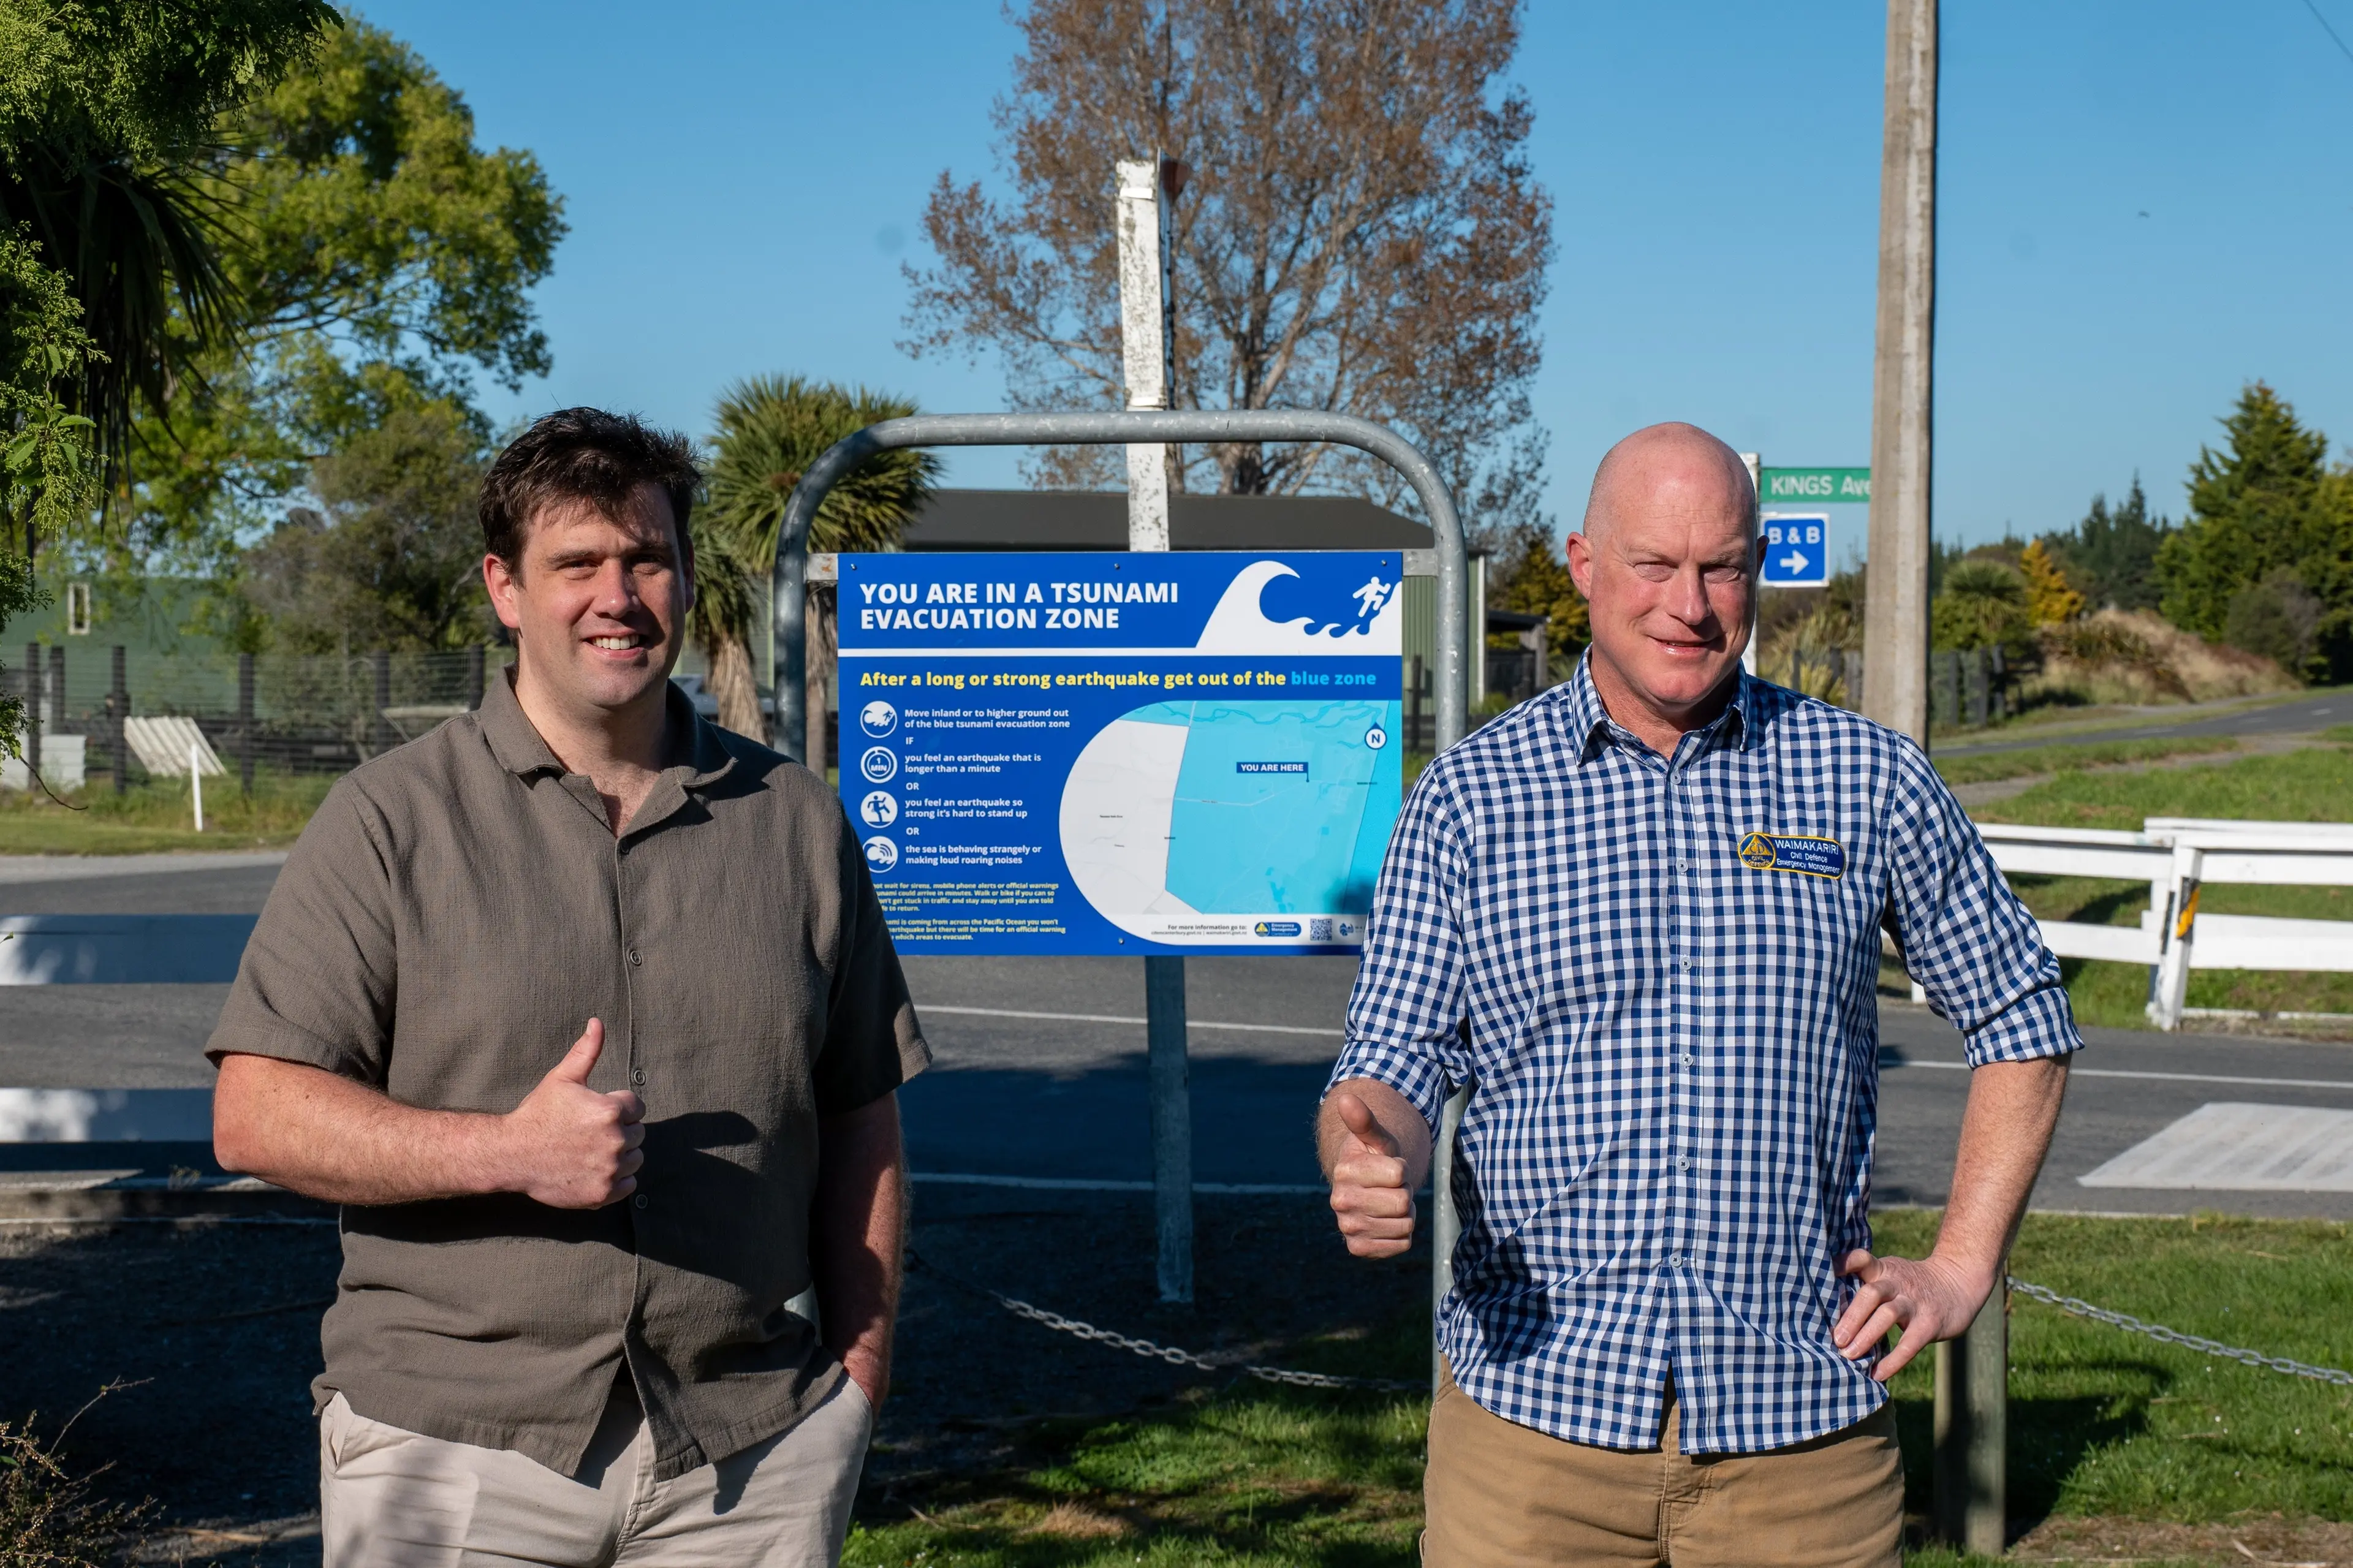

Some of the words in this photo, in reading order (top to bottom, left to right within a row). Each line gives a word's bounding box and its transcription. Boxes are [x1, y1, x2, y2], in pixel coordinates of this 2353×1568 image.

[1771, 475, 1833, 496] KINGS
[1840, 475, 1872, 496] Ave
[1768, 526, 1783, 545] B
[1787, 526, 1802, 545] &
[1806, 526, 1820, 545] B
[860, 584, 917, 604] YOU
[926, 583, 977, 603] ARE
[987, 583, 1015, 603] IN
[1025, 583, 1043, 603] A
[1051, 583, 1177, 603] TSUNAMI
[862, 608, 1036, 629] EVACUATION
[1045, 608, 1118, 628] ZONE
[860, 672, 906, 686] After
[911, 675, 921, 686] a
[927, 672, 964, 689] long
[969, 675, 988, 686] or
[993, 673, 1051, 689] strong
[1056, 672, 1159, 689] earthquake
[1164, 673, 1193, 689] get
[1199, 673, 1228, 685] out
[1233, 671, 1252, 685] of
[1256, 671, 1286, 685] the
[1292, 672, 1329, 685] blue
[1335, 675, 1376, 684] zone
[987, 709, 1016, 719] higher
[1018, 709, 1050, 719] ground
[1371, 733, 1381, 744] N
[957, 754, 1010, 763] earthquake
[906, 765, 934, 775] longer
[958, 798, 1010, 808] earthquake
[906, 811, 935, 819] strong
[948, 845, 988, 855] behaving
[990, 845, 1030, 855] strangely
[1750, 843, 1764, 854] CD
[1775, 839, 1838, 855] WAIMAKARIRI
[906, 856, 938, 866] making
[961, 856, 993, 866] roaring
[1805, 853, 1828, 863] Defence
[1776, 858, 1806, 869] Emergency
[1808, 862, 1840, 874] Management
